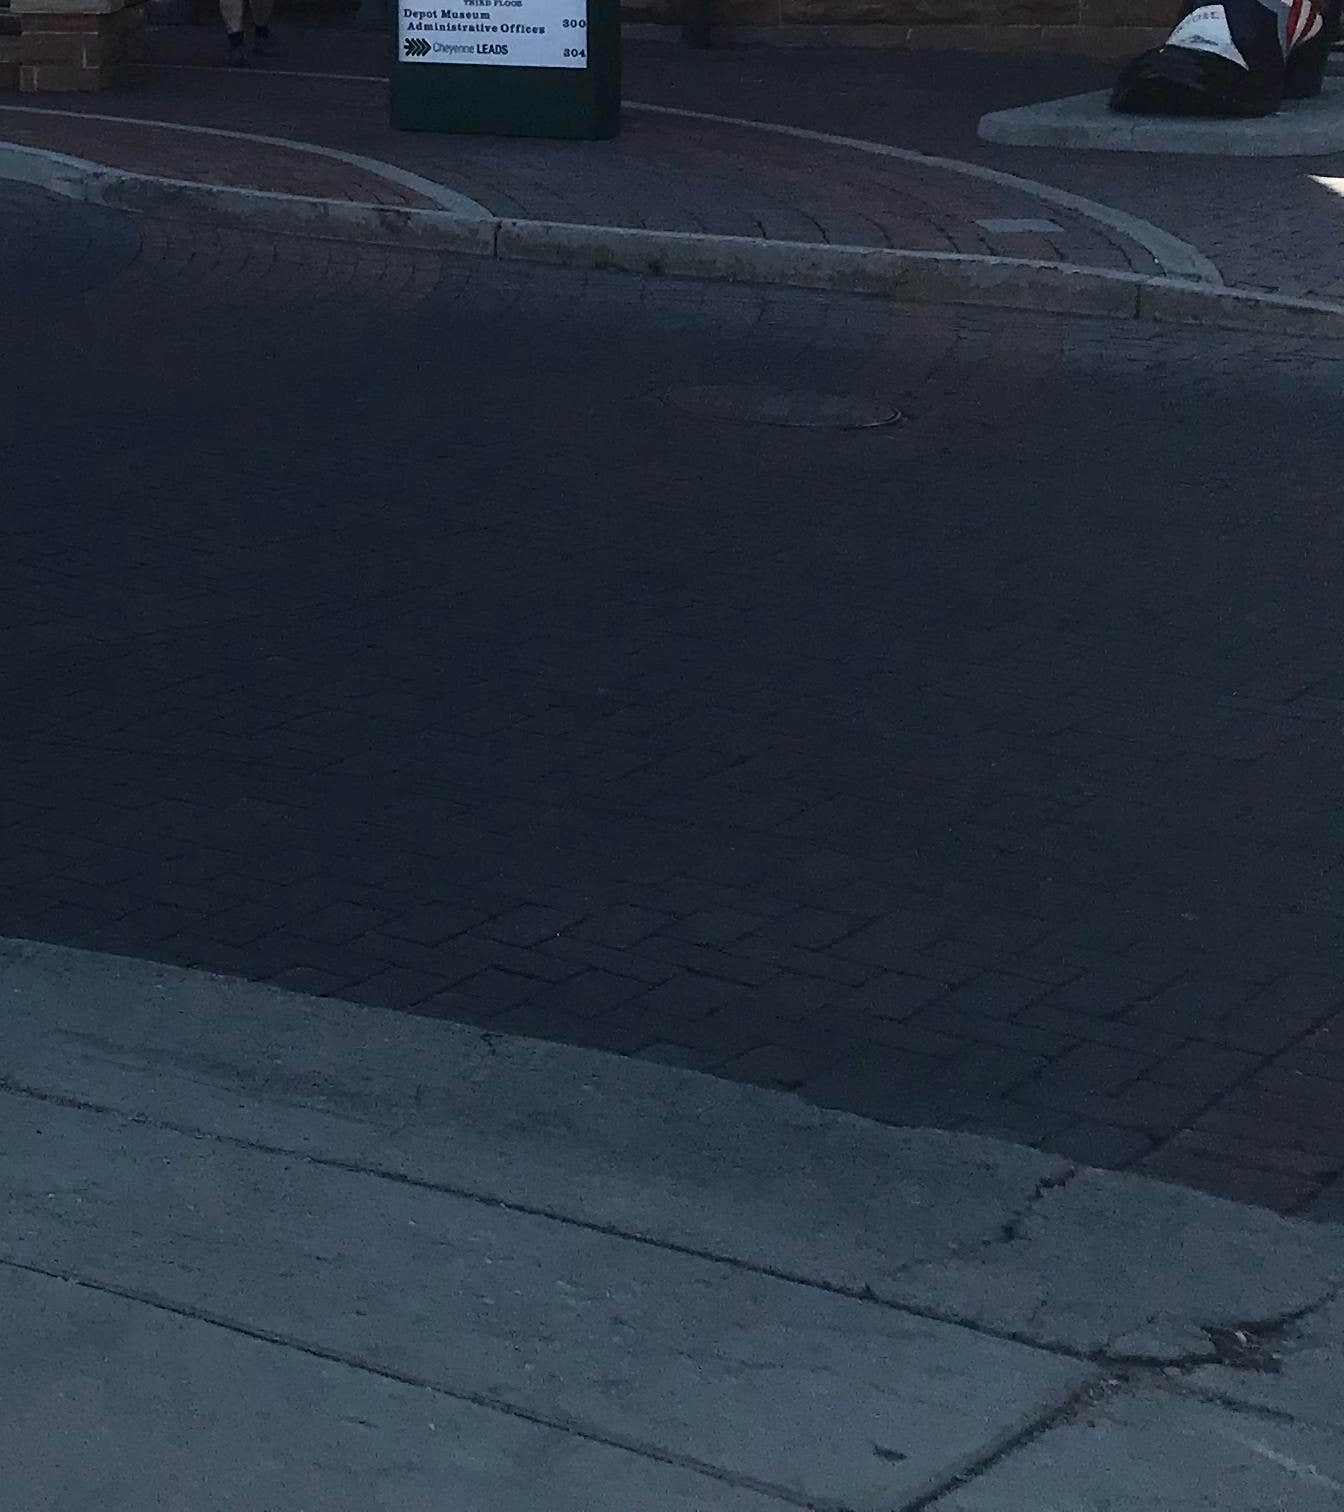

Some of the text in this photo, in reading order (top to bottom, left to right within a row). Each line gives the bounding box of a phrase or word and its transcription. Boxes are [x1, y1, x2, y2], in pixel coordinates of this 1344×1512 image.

[403, 9, 490, 20] Depot Museum
[407, 22, 546, 34] Administrative Offices
[562, 19, 586, 28] 300
[432, 43, 509, 55] Cheyenne LEADS
[563, 49, 586, 58] 304
